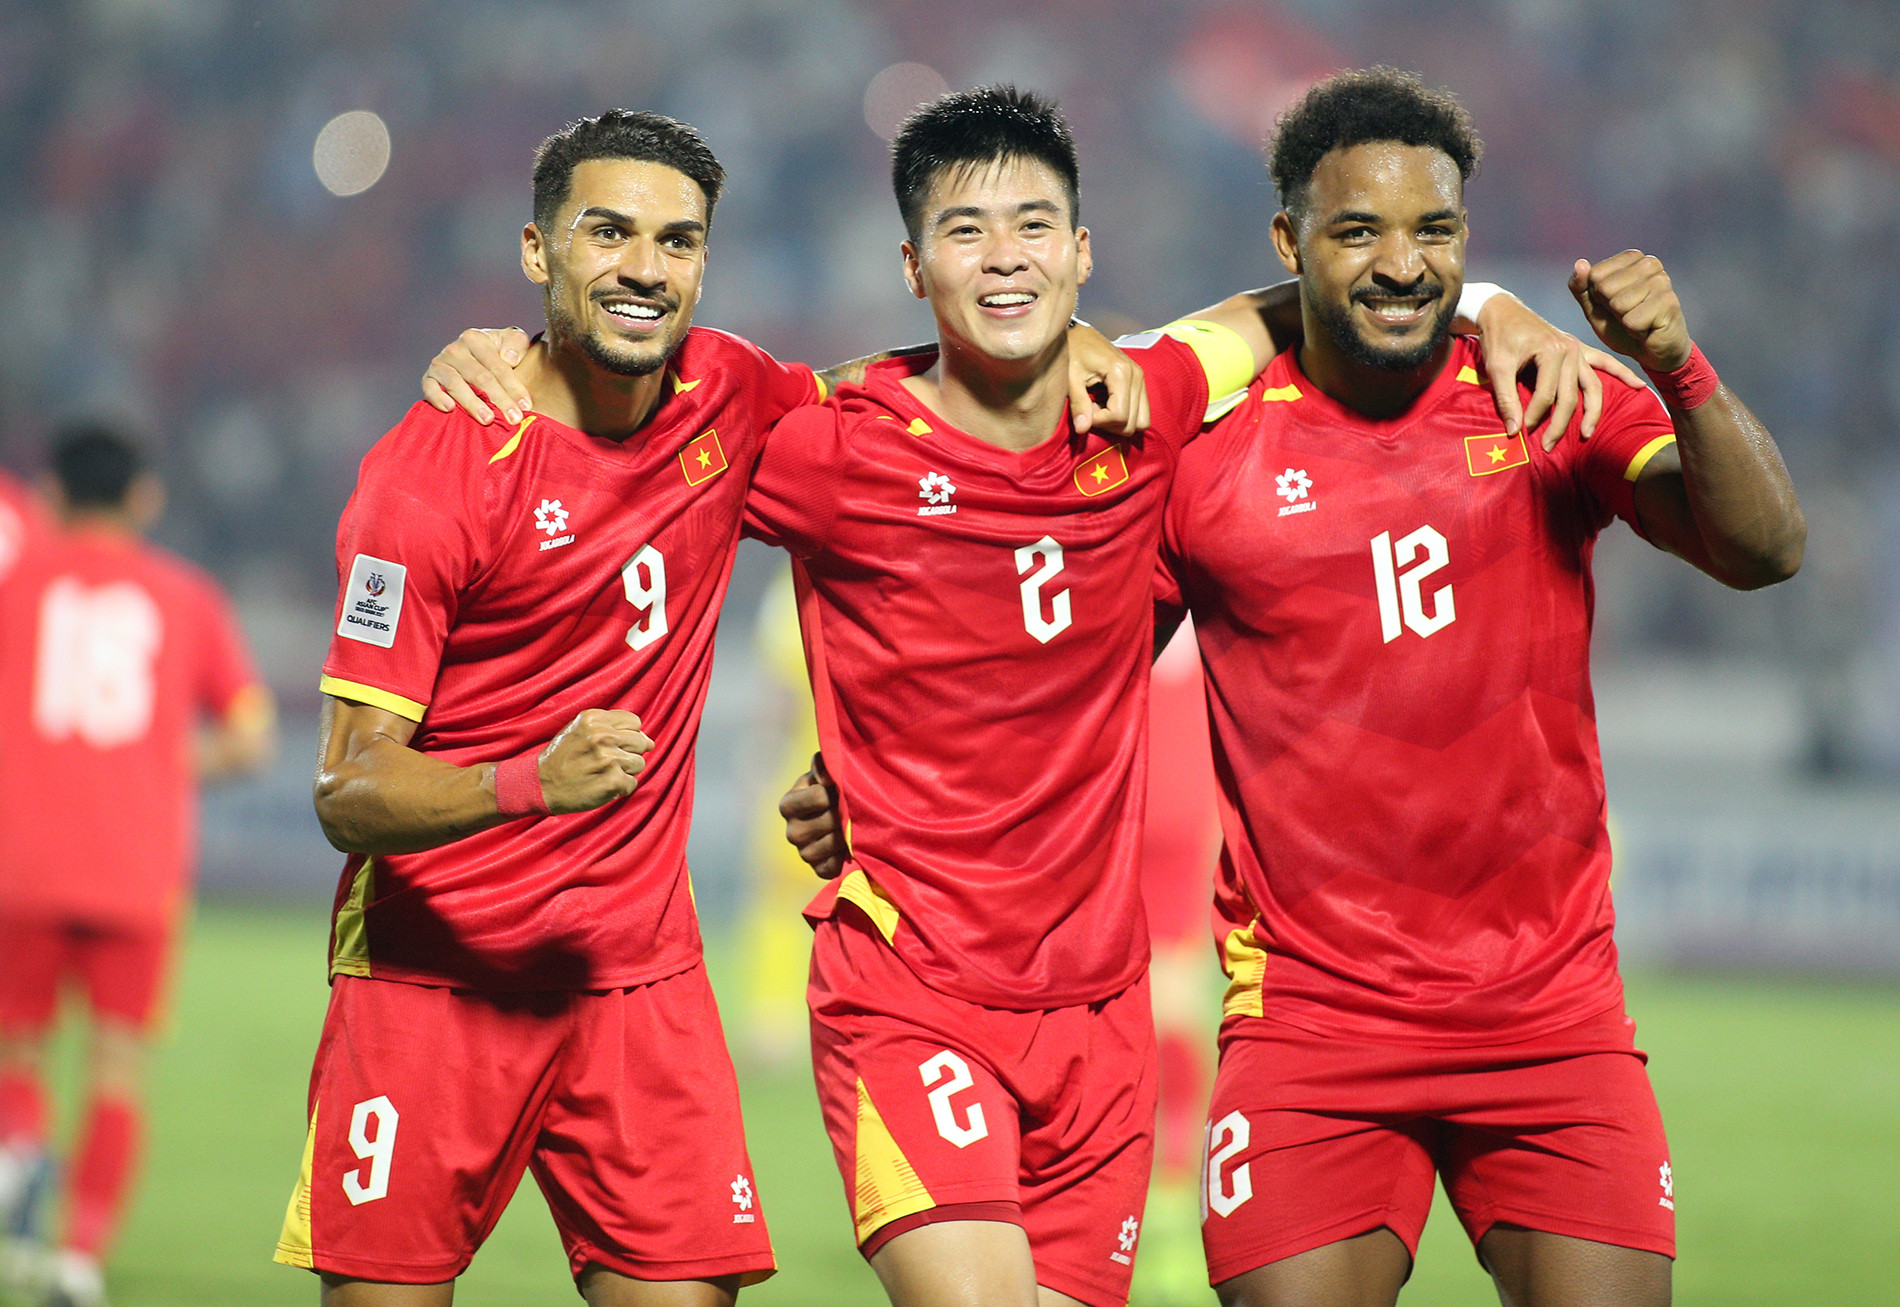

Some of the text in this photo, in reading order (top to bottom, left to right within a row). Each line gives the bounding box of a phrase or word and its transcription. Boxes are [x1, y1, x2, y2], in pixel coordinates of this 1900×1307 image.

[346, 614, 390, 632] QUALIFIERS
[356, 601, 374, 610] ASIAN
[620, 542, 669, 652] 9
[1014, 534, 1073, 645] 2
[1369, 523, 1457, 645] 12
[342, 1094, 400, 1207] 9
[918, 1049, 990, 1150] 2
